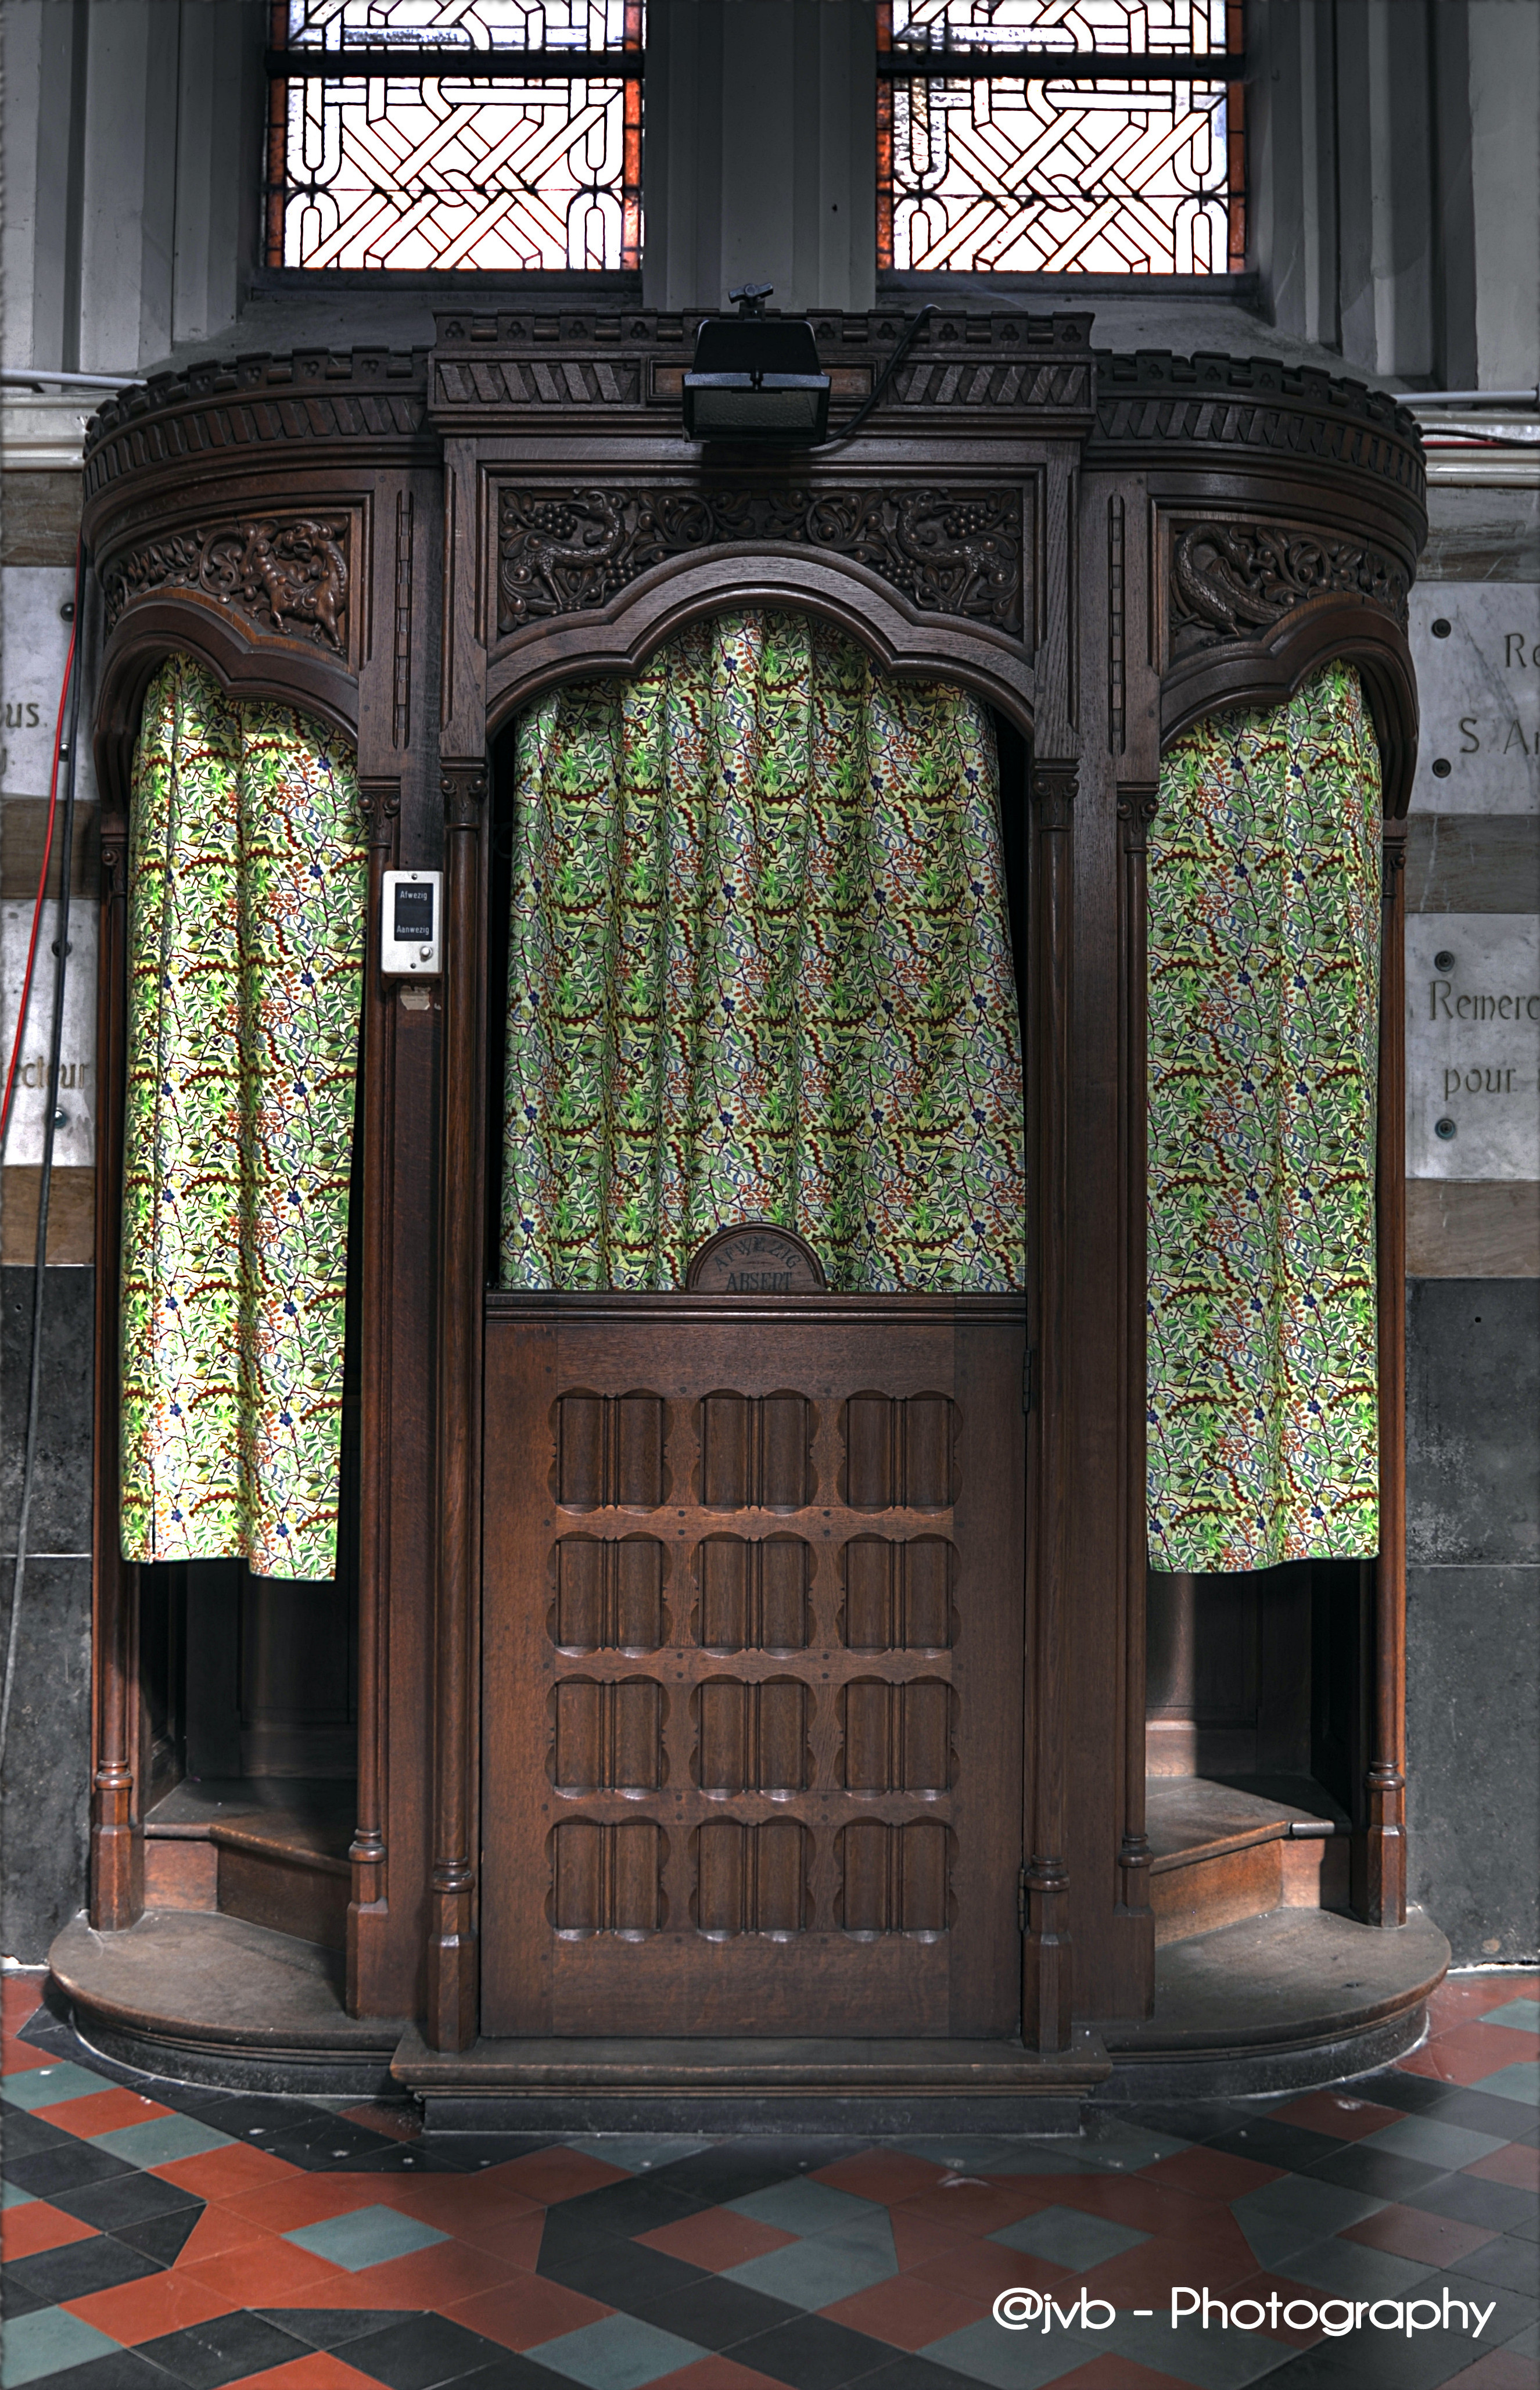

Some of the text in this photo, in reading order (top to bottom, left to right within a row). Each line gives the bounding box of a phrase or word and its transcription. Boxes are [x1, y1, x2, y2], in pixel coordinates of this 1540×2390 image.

[0, 702, 48, 729] us.
[400, 890, 428, 900] Afwezig
[396, 924, 430, 935] Aanwezig
[1428, 979, 1540, 1021] Remerc
[1444, 1068, 1517, 1101] pour
[713, 1236, 802, 1272] AFWEZIG
